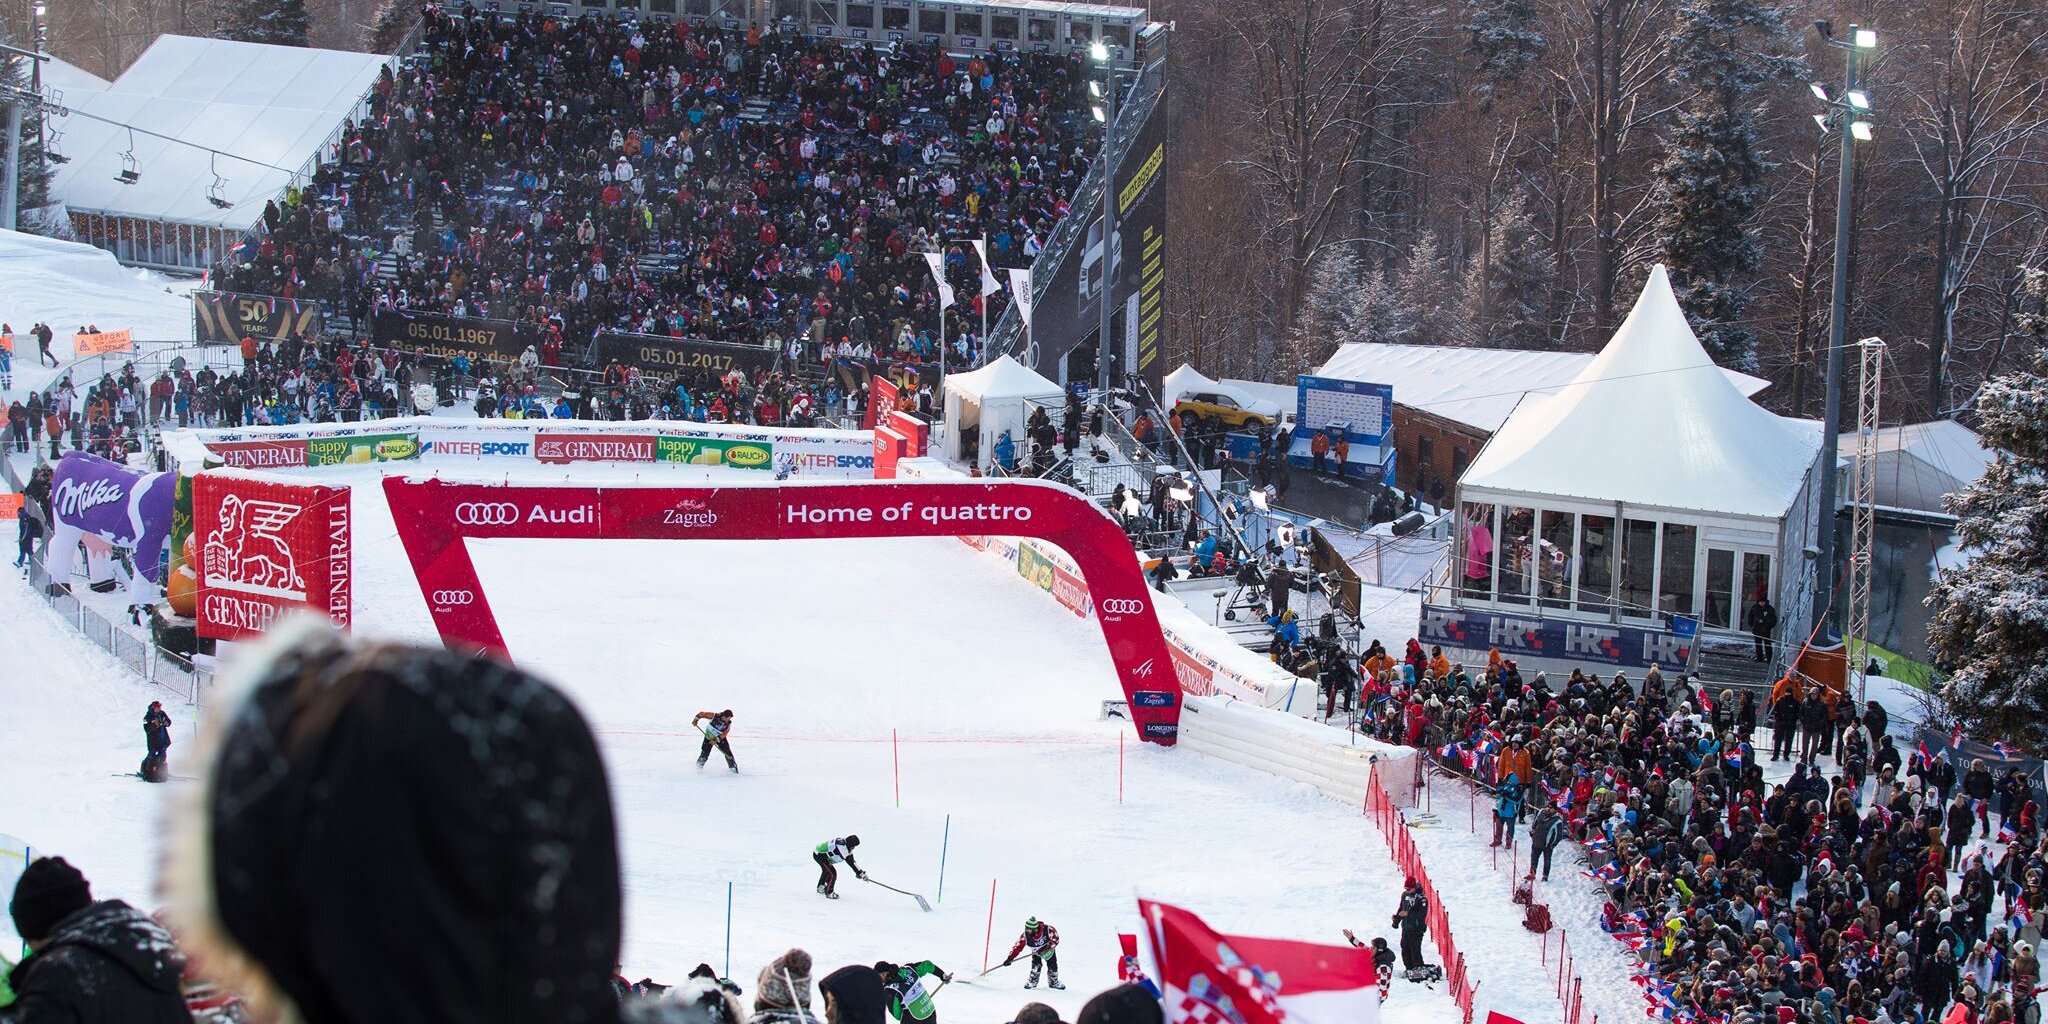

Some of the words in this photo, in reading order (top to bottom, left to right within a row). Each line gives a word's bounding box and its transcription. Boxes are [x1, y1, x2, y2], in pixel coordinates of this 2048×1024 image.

[240, 300, 268, 322] 50
[241, 324, 268, 333] YEARS
[408, 322, 497, 345] 05.01.1967
[640, 347, 733, 370] 05.01.2017
[311, 440, 349, 455] happy
[386, 443, 412, 453] RAUCH
[434, 441, 530, 455] INTERSPORT
[565, 441, 653, 459] GENERALI
[658, 437, 696, 455] happy
[737, 451, 764, 460] RAUCH
[222, 447, 305, 466] GENERALI
[318, 452, 343, 465] day
[666, 451, 689, 463] day
[55, 477, 125, 519] Milka
[527, 504, 594, 523] Audi
[663, 509, 718, 528] Zagreb
[787, 504, 873, 523] Home
[881, 502, 913, 521] of
[920, 502, 1033, 525] quattro
[328, 503, 348, 631] GENERALI
[1489, 616, 1544, 649] HRT
[1565, 624, 1619, 658] HRT
[1143, 697, 1166, 706] Zagreb
